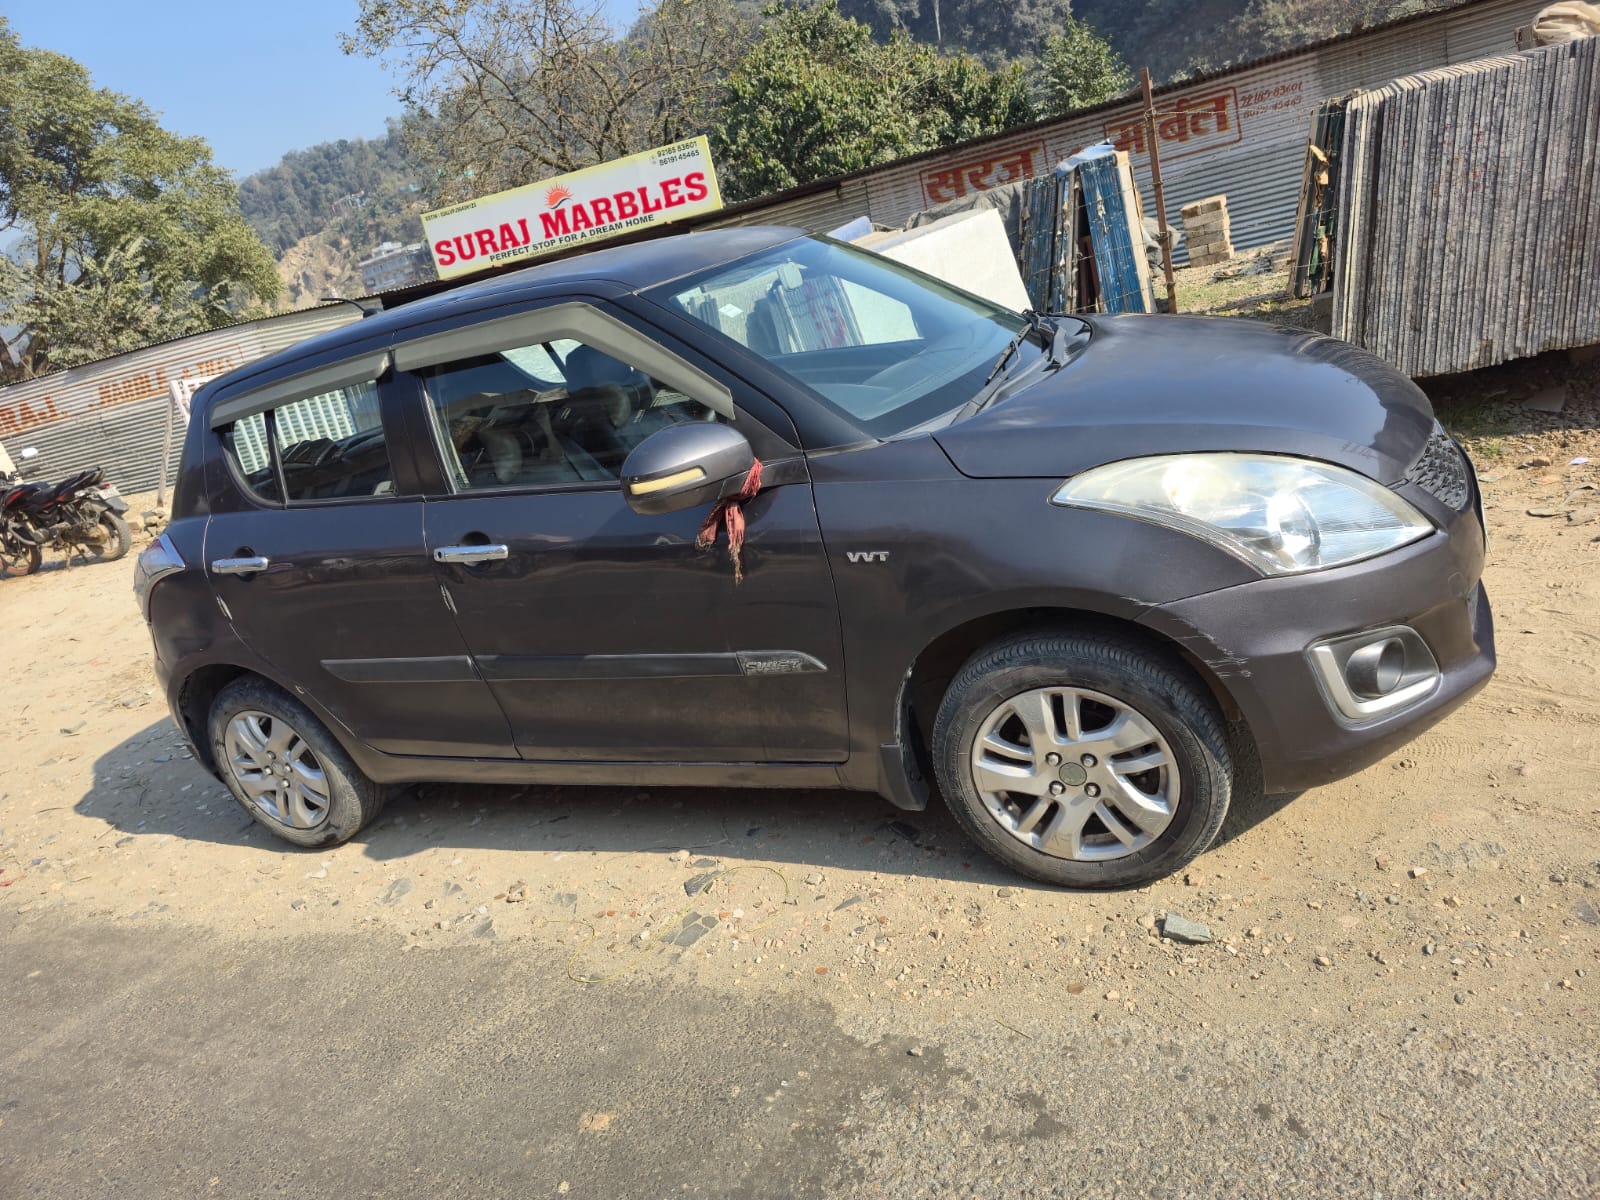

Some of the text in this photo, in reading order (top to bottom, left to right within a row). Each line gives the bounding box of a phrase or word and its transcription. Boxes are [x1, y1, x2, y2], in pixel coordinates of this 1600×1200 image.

[434, 218, 531, 266] SURAJ
[539, 172, 708, 239] MARBLES
[490, 246, 529, 262] PERFECT
[532, 239, 556, 251] STOP
[559, 233, 578, 244] FOR
[580, 231, 587, 240] A
[590, 223, 623, 237] DREAM
[626, 214, 655, 227] HOME
[847, 551, 889, 563] VVT
